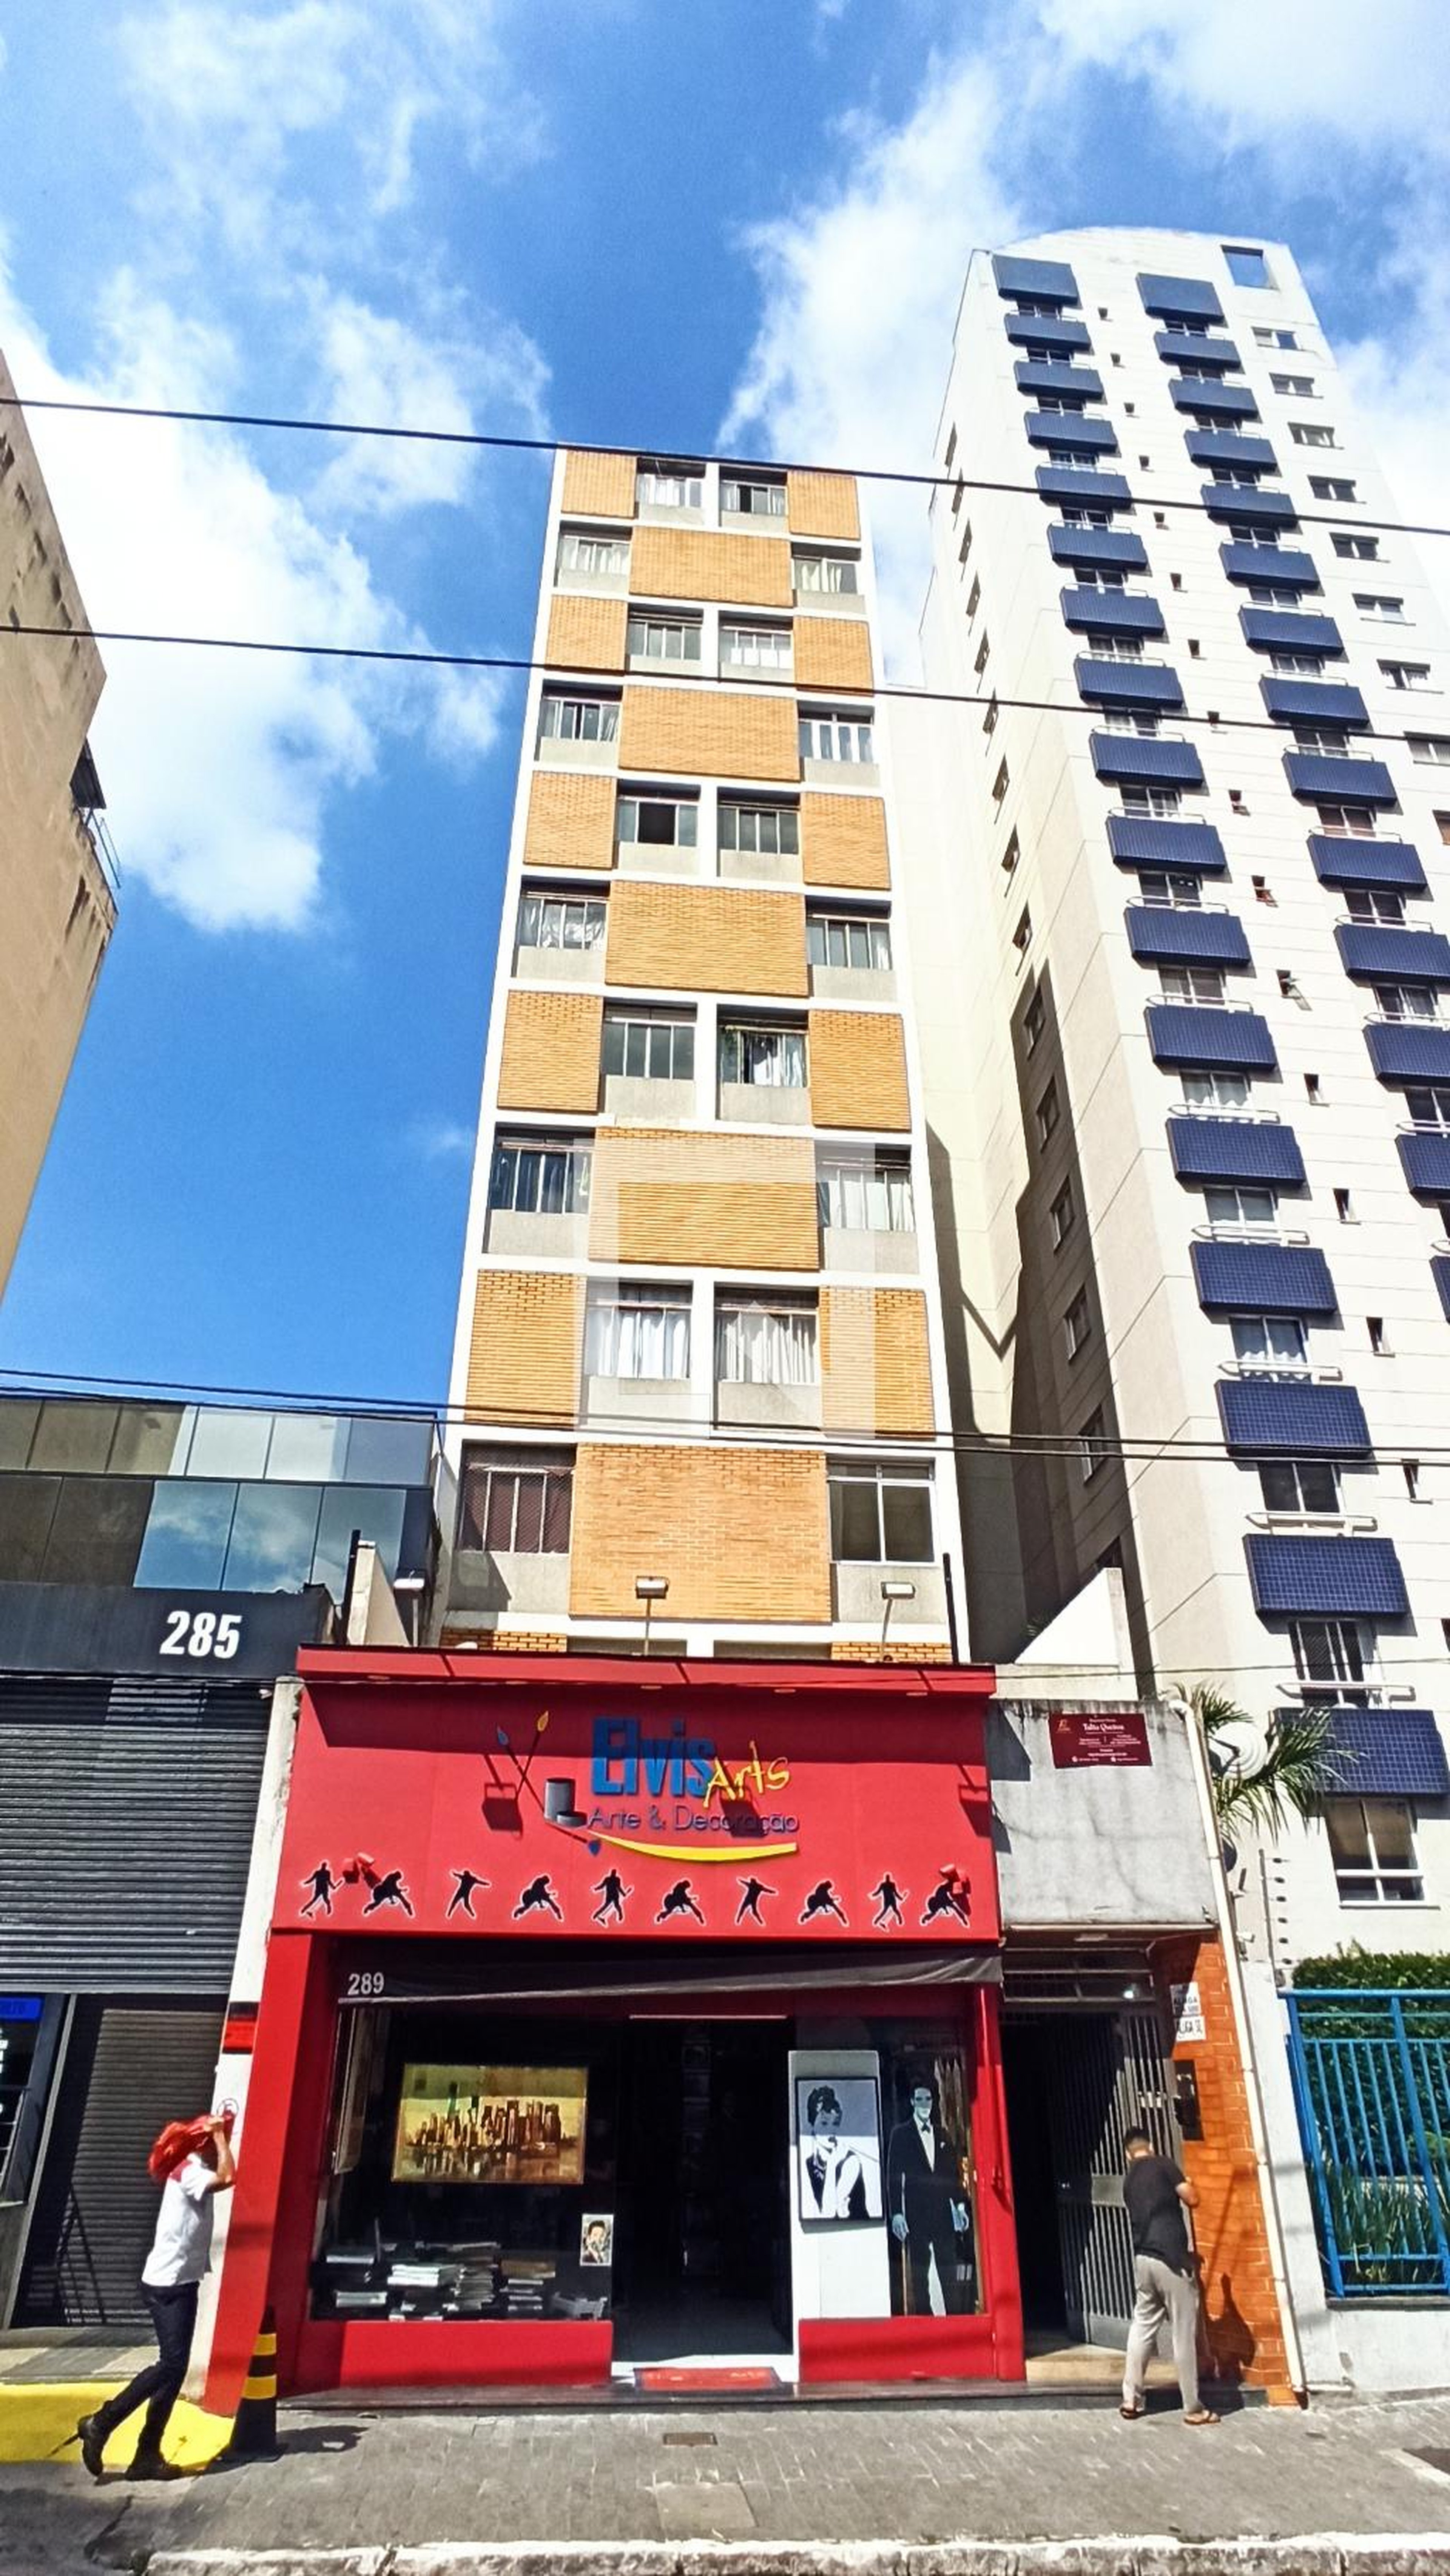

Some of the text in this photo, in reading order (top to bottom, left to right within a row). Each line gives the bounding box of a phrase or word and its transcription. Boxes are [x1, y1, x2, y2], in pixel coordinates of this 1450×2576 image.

[159, 1610, 242, 1659] 285
[591, 1716, 790, 1807] Elvis Arts
[588, 1804, 799, 1837] Arte & Decoração
[347, 1972, 384, 1996] 289
